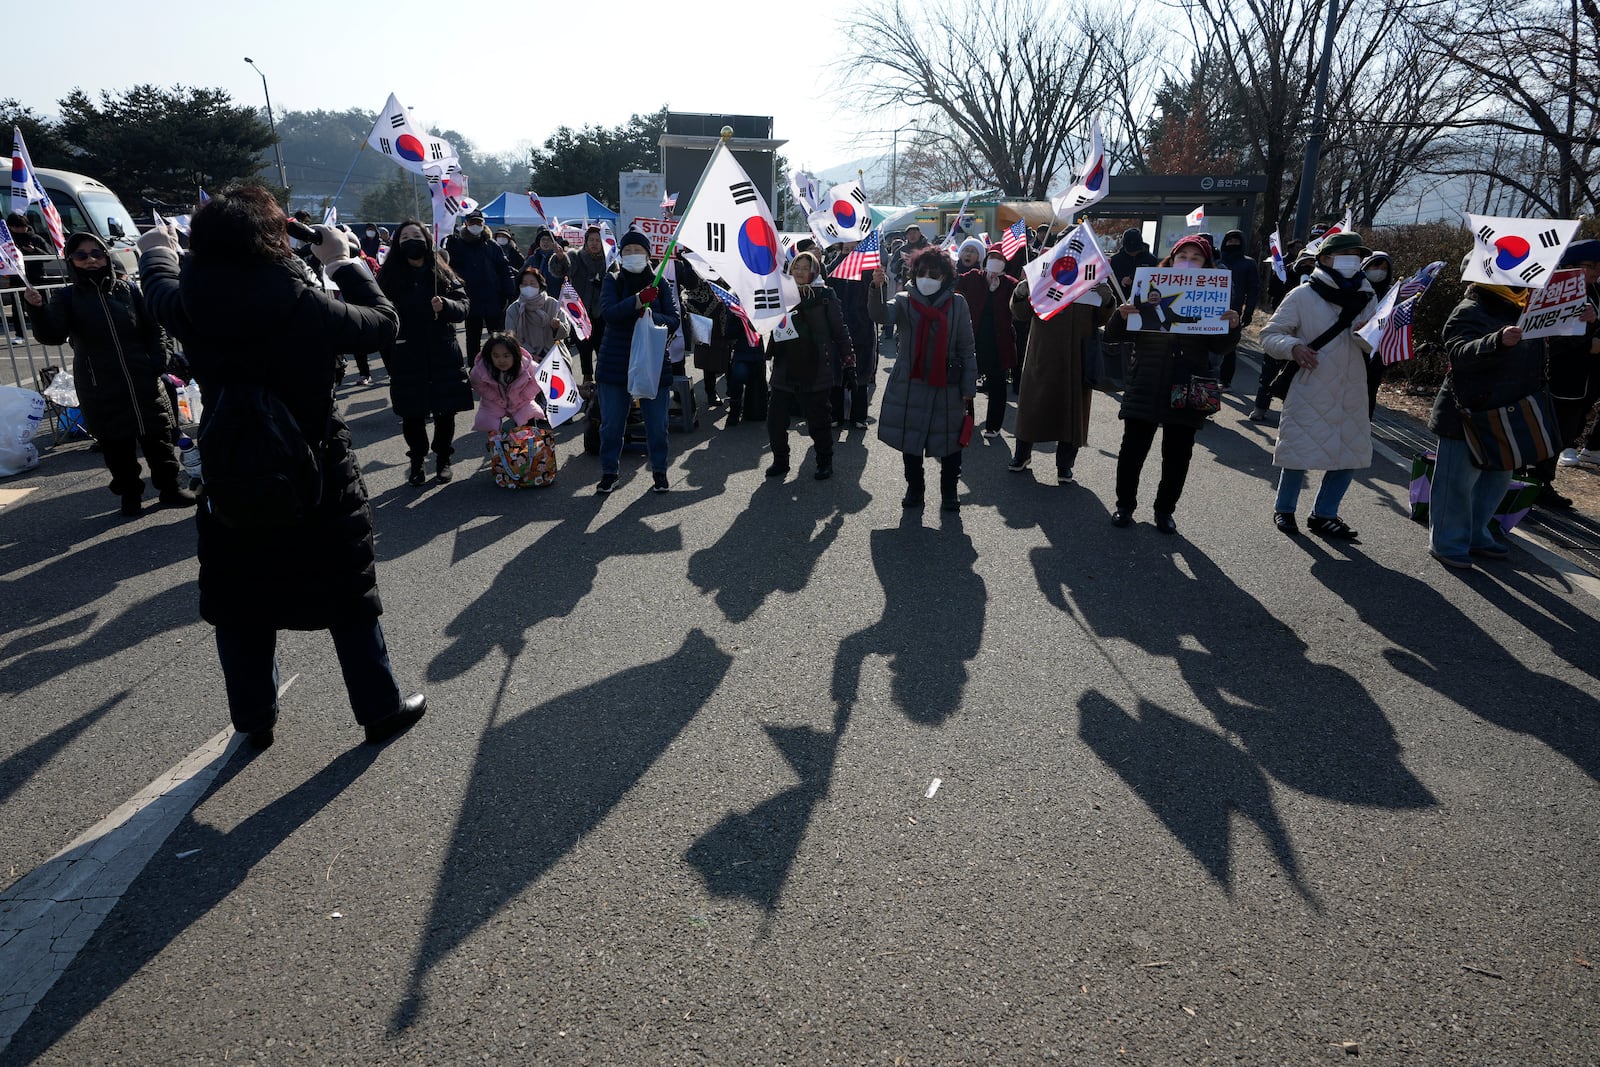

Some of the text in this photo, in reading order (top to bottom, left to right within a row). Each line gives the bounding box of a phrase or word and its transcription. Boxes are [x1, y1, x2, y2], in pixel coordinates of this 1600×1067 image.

[1150, 273, 1229, 288] 지키자!! 윤석열
[1185, 290, 1227, 303] 지키자!!
